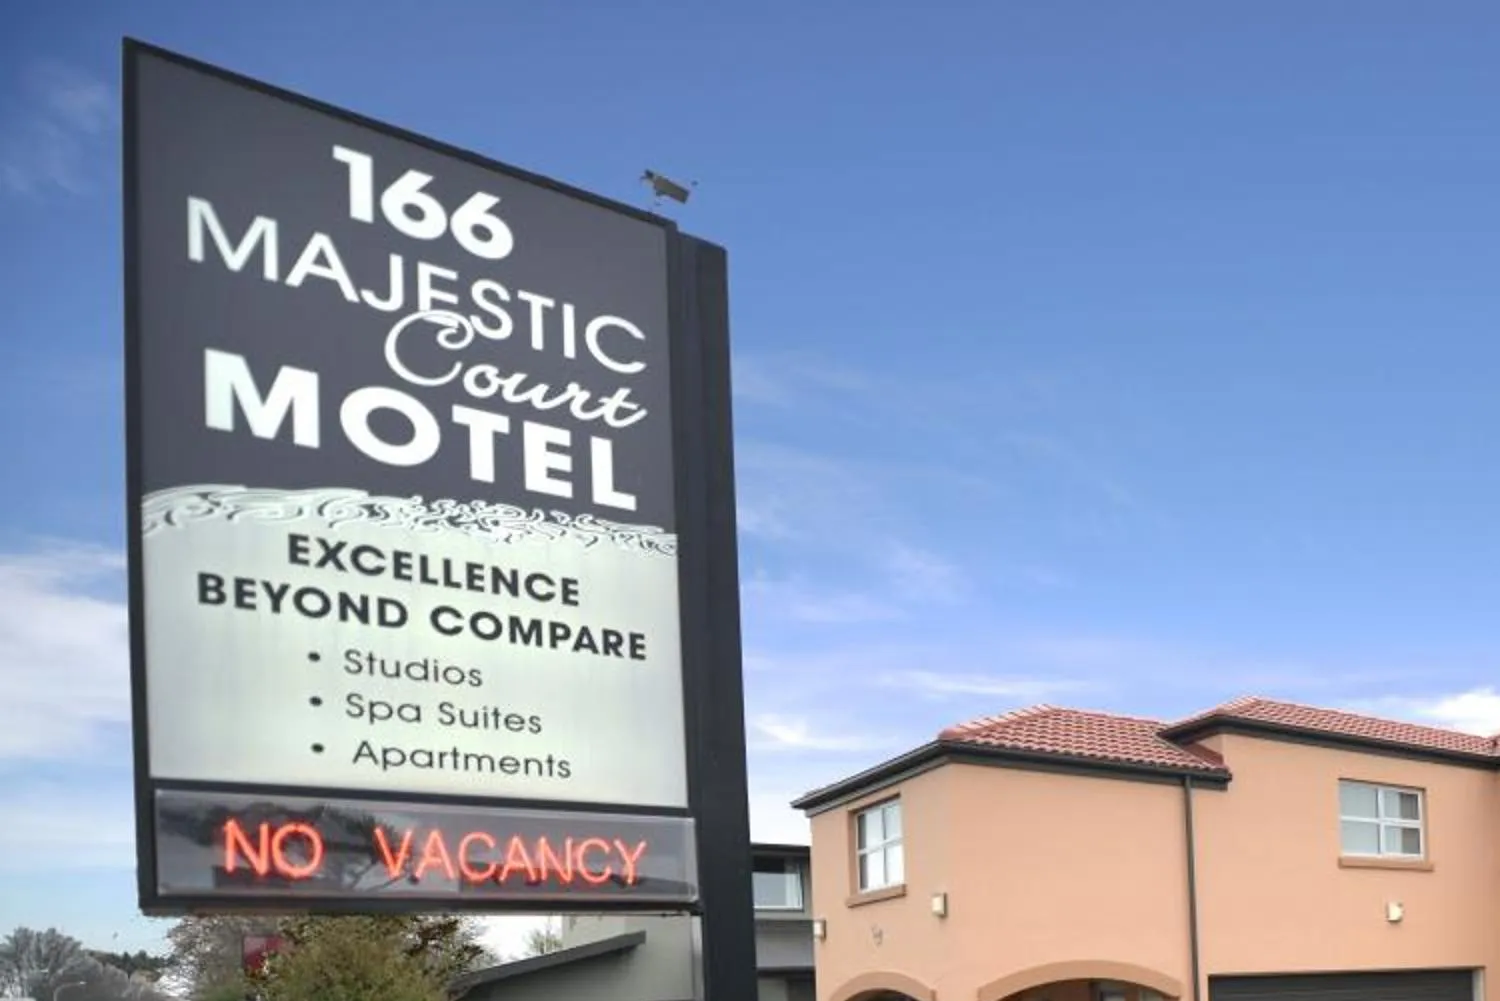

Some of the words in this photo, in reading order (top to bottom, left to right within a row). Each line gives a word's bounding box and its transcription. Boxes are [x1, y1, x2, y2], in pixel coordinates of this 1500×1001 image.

[333, 145, 514, 259] 166
[187, 196, 647, 374] MAJESTIC
[385, 310, 647, 428] Court
[205, 348, 637, 511] MOTEL
[287, 533, 580, 606] EXCELLENCE
[198, 572, 408, 629] BEYOND
[430, 605, 647, 661] COMPARE
[343, 649, 483, 688] Studios
[345, 693, 422, 726] Spa
[438, 702, 542, 735] Suites
[352, 740, 572, 779] Apartments
[221, 816, 324, 878] NO
[373, 825, 648, 885] VACANCY
